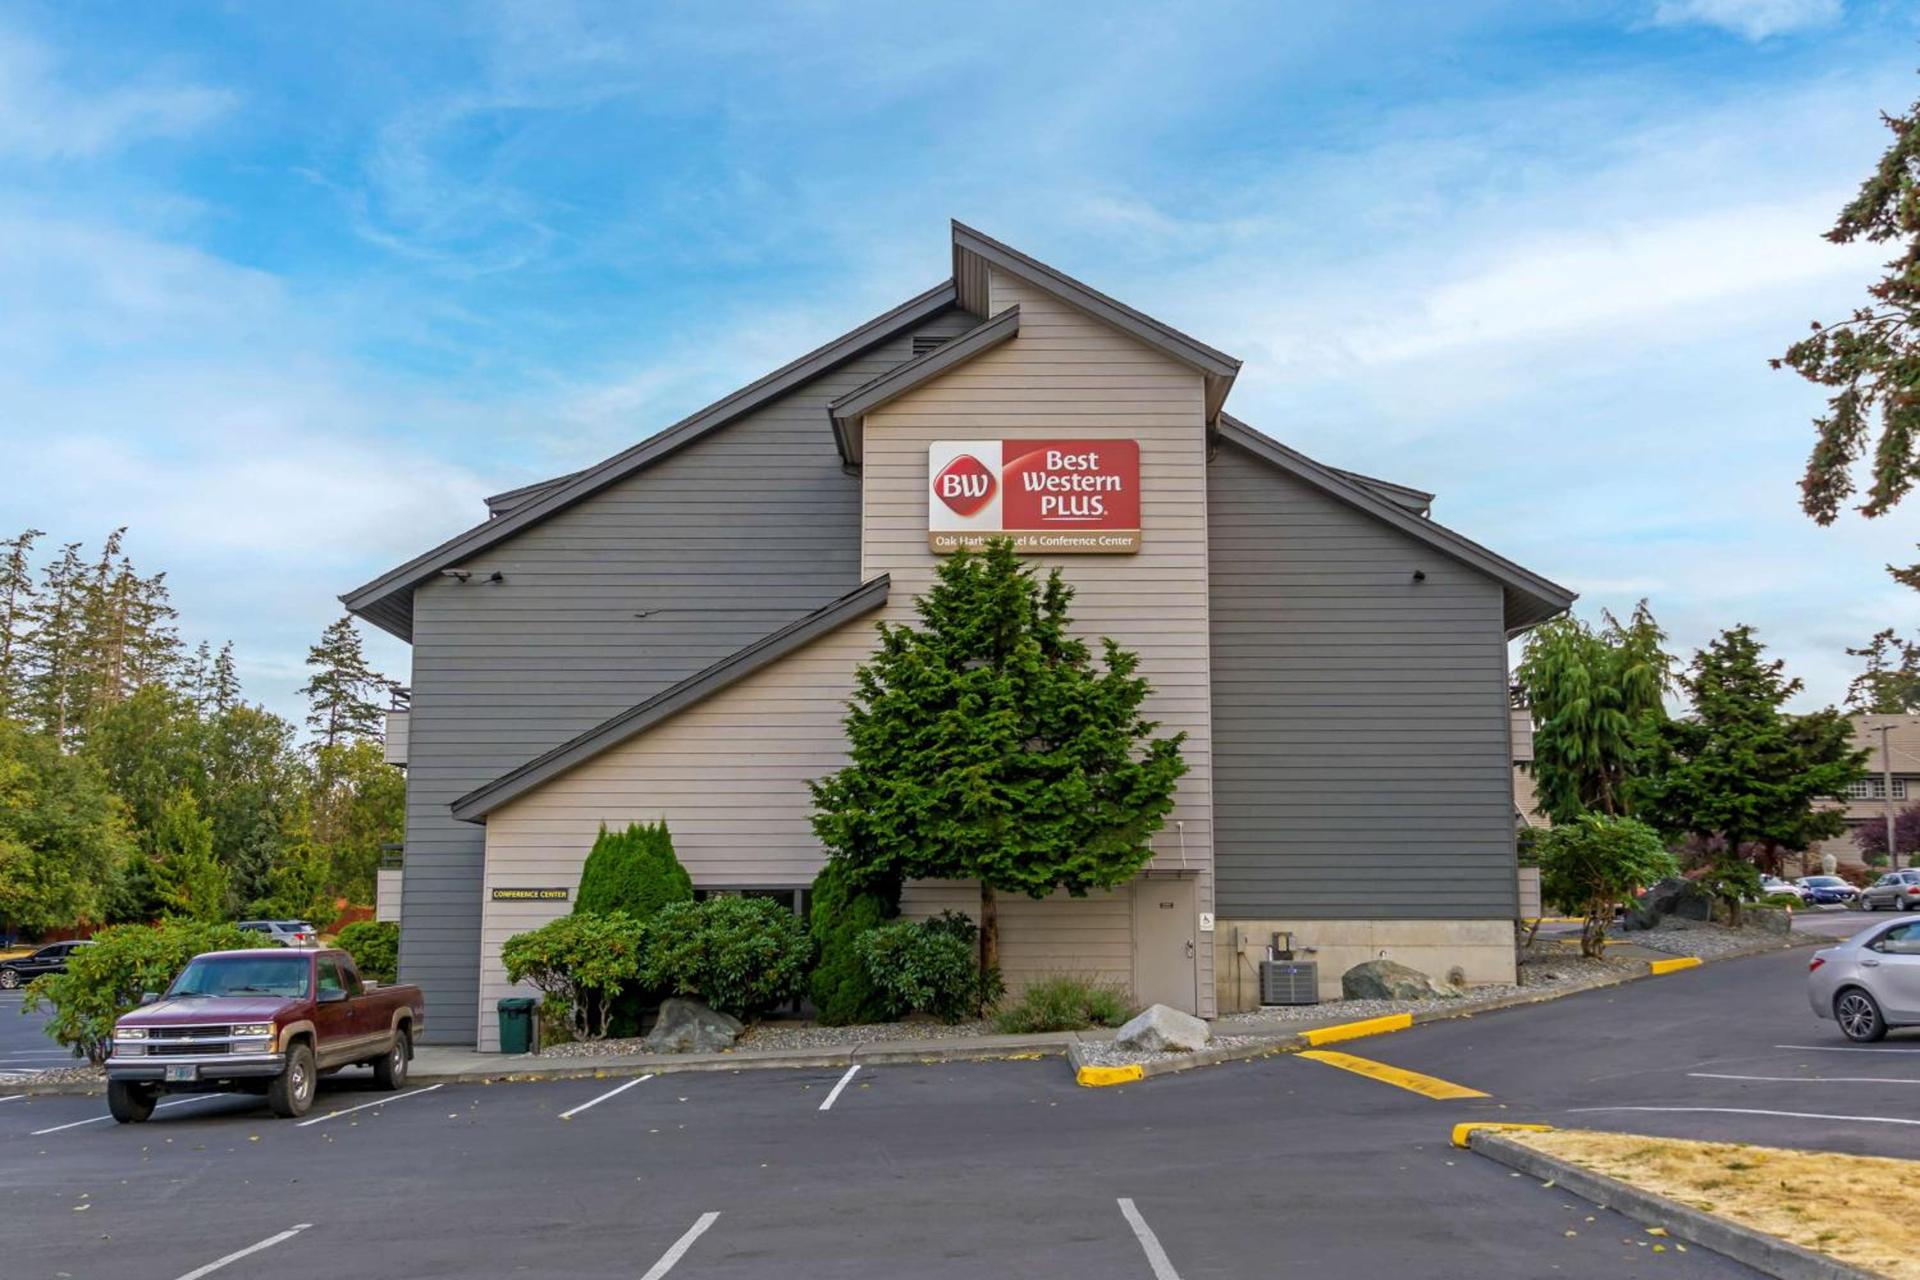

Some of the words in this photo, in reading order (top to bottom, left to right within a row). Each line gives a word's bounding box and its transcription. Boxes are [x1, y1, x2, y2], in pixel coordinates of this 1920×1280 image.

[1046, 450, 1099, 470] Best
[943, 474, 988, 497] BW
[1023, 471, 1122, 491] Western
[936, 535, 957, 546] Oak
[1029, 536, 1038, 546] &
[1040, 535, 1097, 546] Conference
[1099, 536, 1134, 546] Center
[494, 890, 539, 898] CONFERENCE
[540, 890, 567, 898] CENTER
